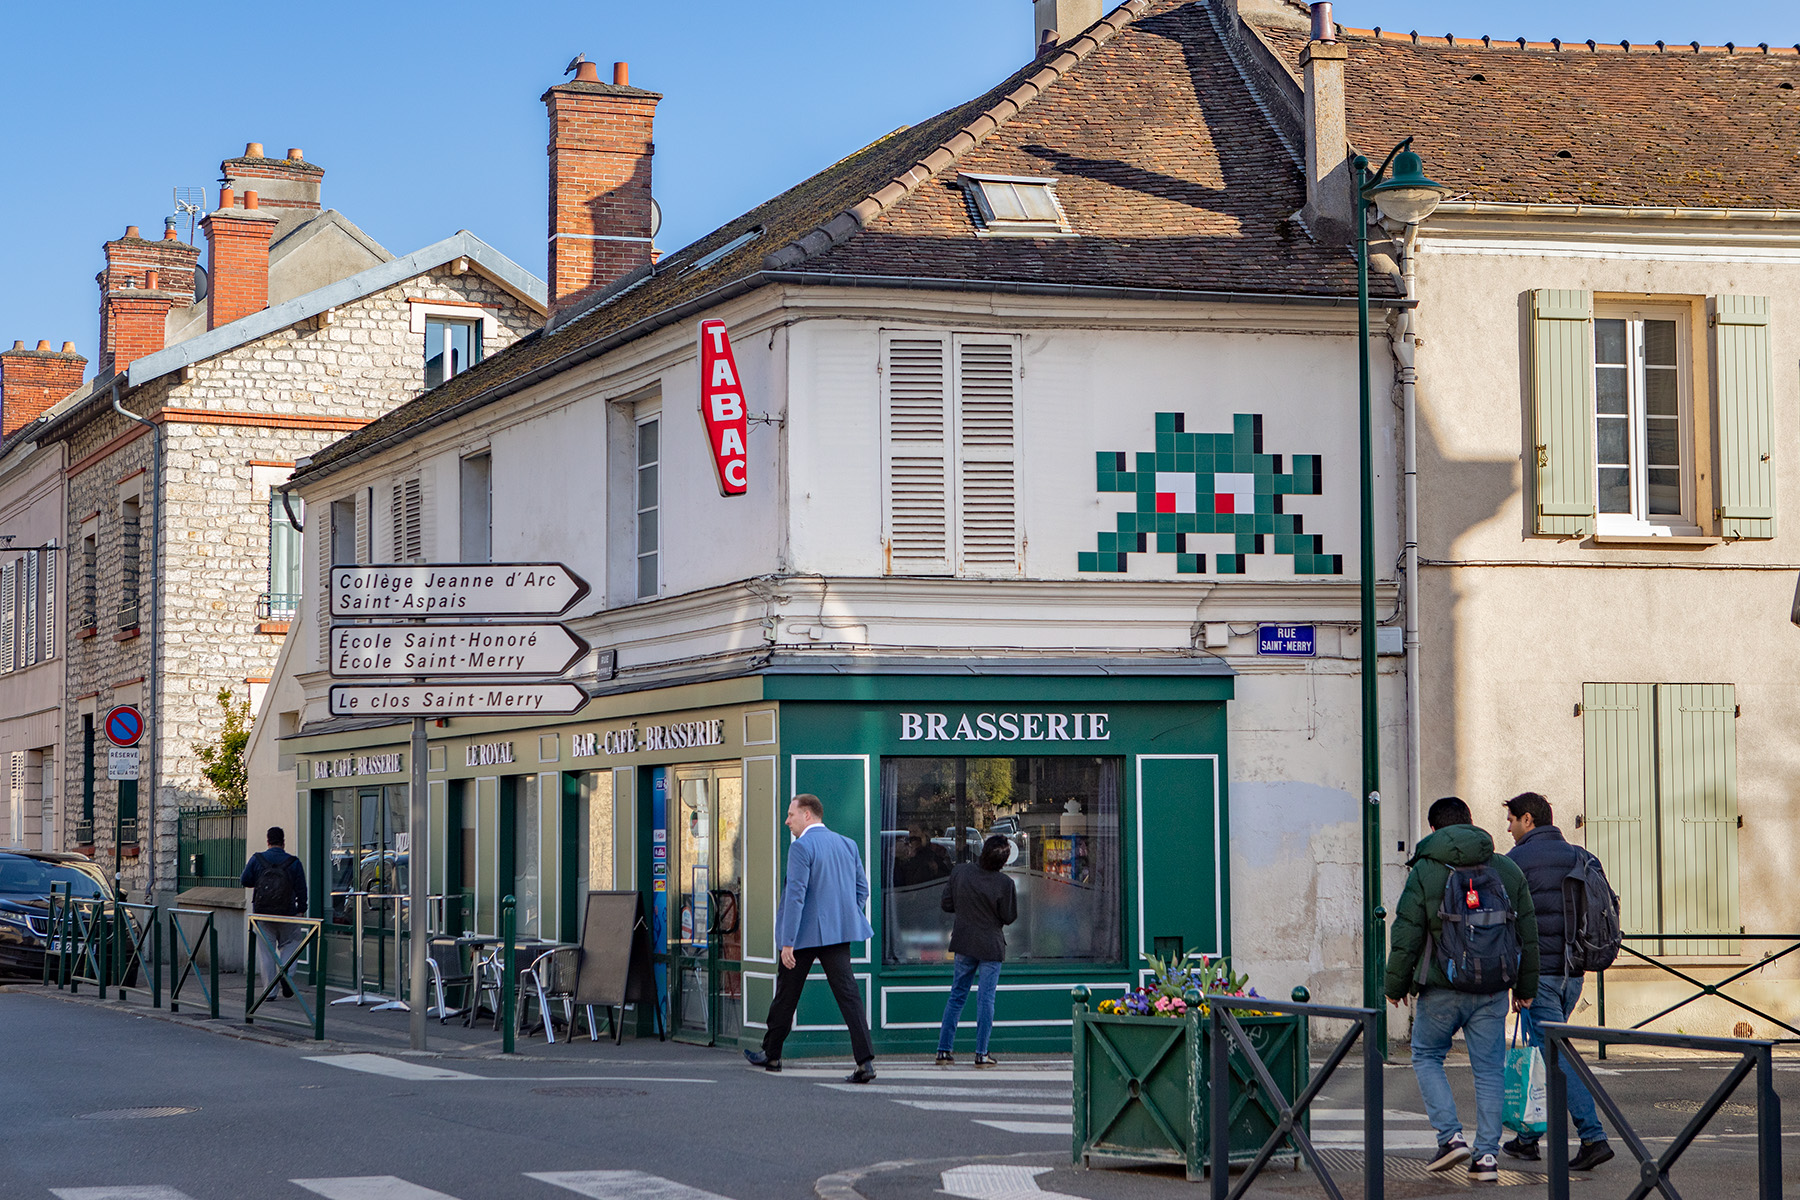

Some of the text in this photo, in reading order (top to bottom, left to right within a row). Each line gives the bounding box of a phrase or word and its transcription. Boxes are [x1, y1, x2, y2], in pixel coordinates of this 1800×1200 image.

[707, 326, 747, 487] TABAC
[340, 572, 556, 593] Collège Jeanne d'Arc
[340, 593, 467, 612] Saint-Aspais
[339, 630, 537, 649] École Saint-Honoré
[1277, 628, 1296, 638] RUE
[1261, 640, 1312, 652] SAINT-MERRY
[339, 650, 525, 671] École Saint-Merry
[339, 691, 543, 709] Le clos Saint-Merry
[899, 713, 1110, 741] BRASSERIE
[466, 742, 513, 766] LE ROYAL
